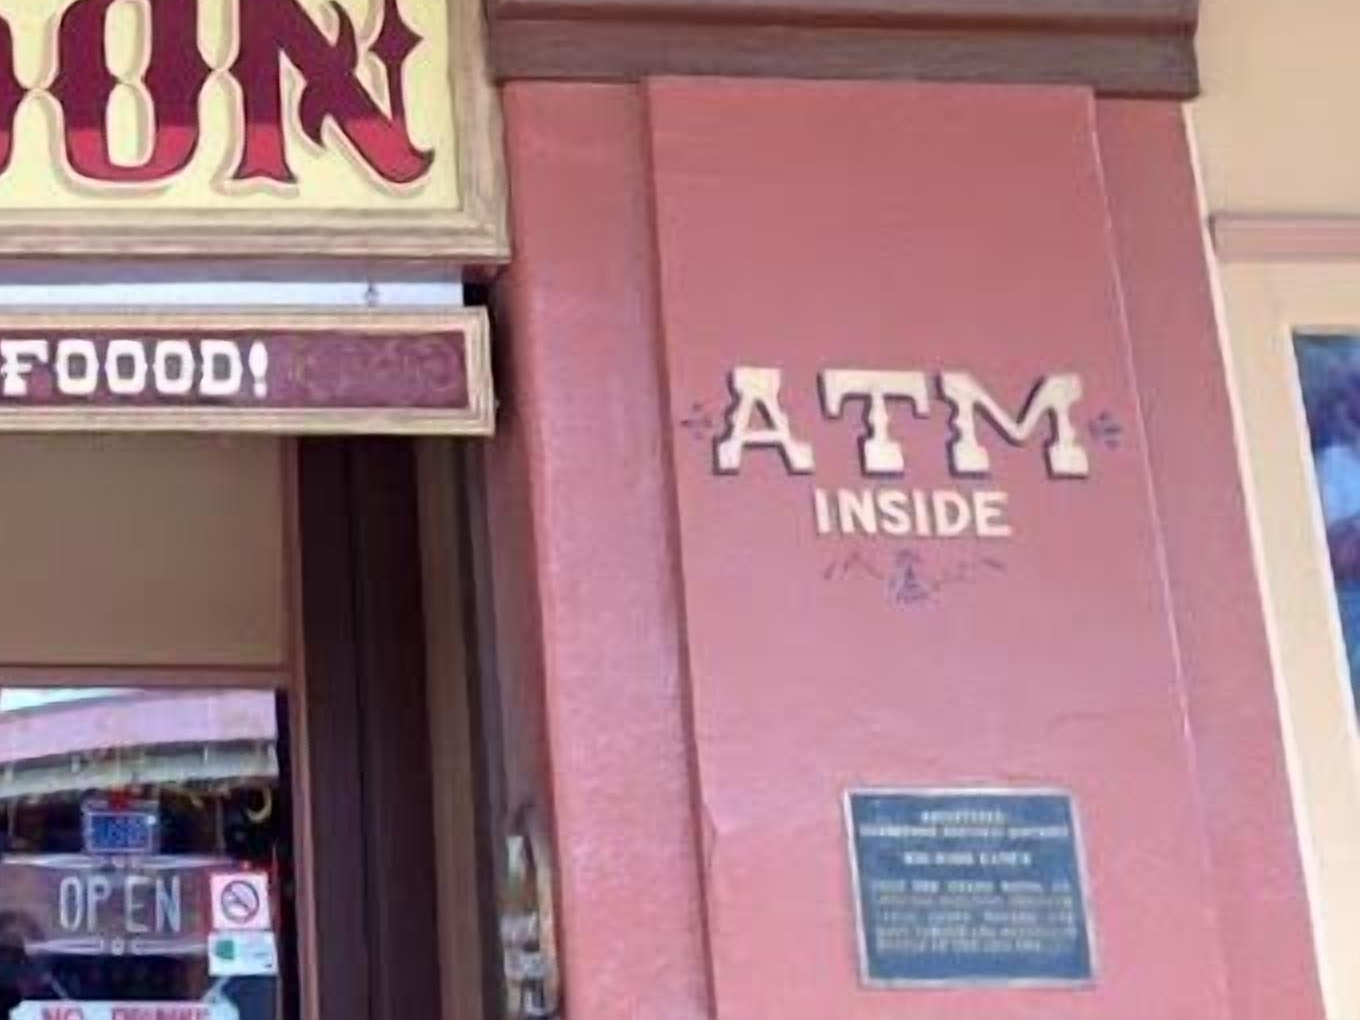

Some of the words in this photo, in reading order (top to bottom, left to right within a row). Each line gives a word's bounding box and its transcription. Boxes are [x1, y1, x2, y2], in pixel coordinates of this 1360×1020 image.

[0, 339, 270, 399] FOOOD!
[715, 365, 1088, 478] ATM
[814, 487, 1012, 537] INSIDE
[58, 874, 183, 934] OPEN
